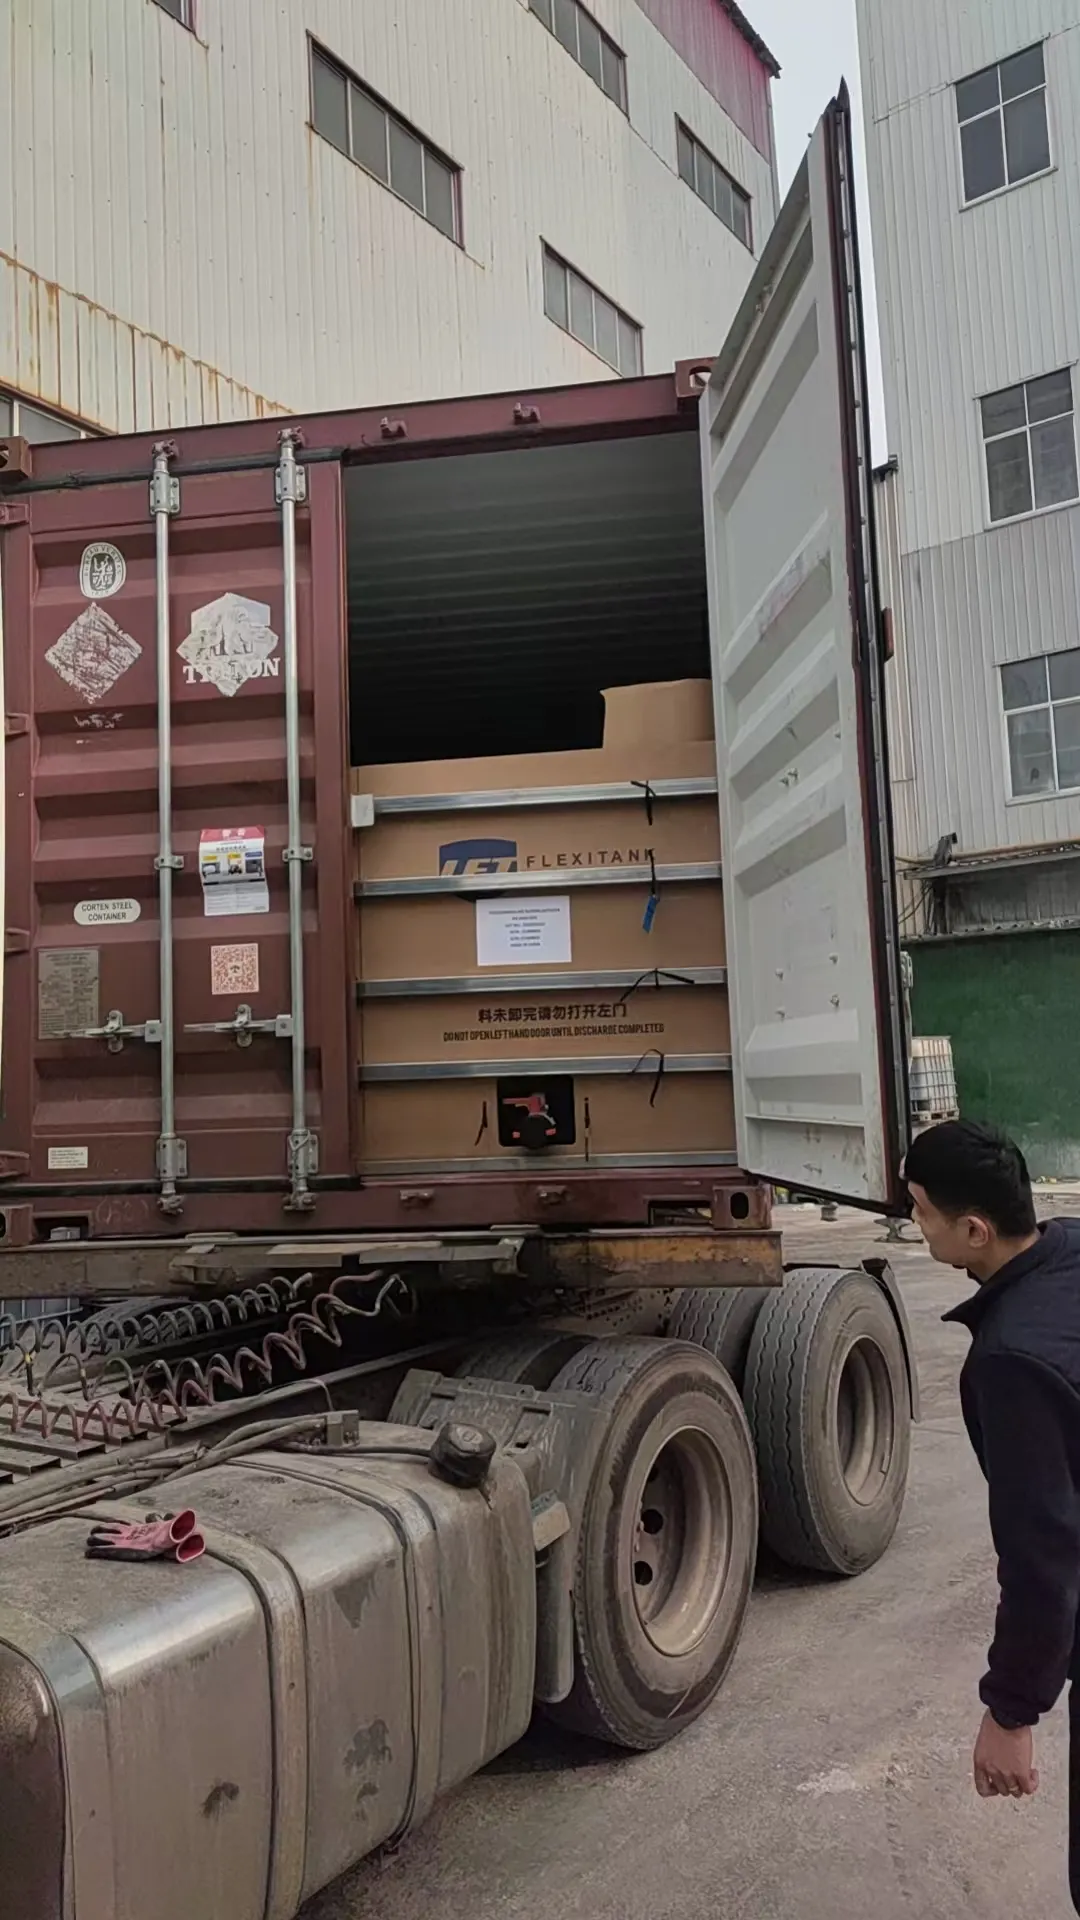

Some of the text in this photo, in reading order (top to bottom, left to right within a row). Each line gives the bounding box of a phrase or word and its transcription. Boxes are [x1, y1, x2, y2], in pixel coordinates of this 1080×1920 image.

[526, 847, 655, 869] FLEXITANK
[81, 901, 133, 913] CORTEN STEEL
[88, 912, 127, 922] CONTAINER
[477, 1003, 628, 1024] 料未卸完请勿打开左门
[443, 1031, 454, 1042] DO
[454, 1031, 469, 1042] NOT
[469, 1030, 490, 1041] OPEN
[490, 1029, 508, 1040] LEFT
[508, 1028, 530, 1039] HAND
[530, 1027, 551, 1038] DOOR
[550, 1026, 574, 1037] UNTIL
